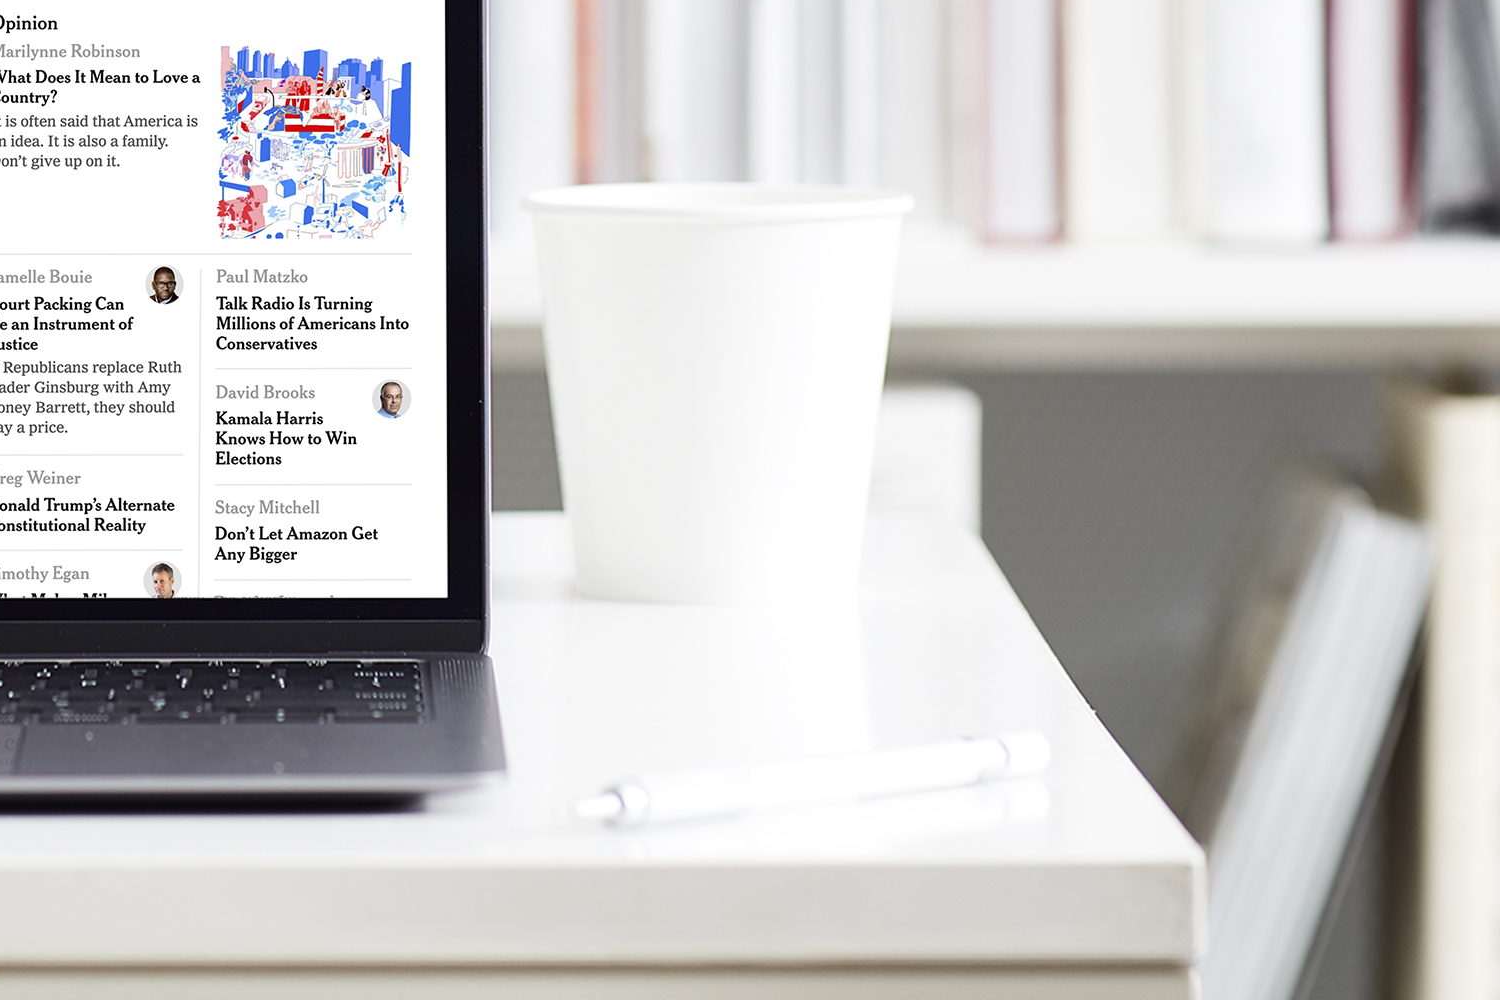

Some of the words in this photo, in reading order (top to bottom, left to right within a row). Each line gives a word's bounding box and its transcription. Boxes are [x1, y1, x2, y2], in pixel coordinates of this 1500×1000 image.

[71, 44, 140, 58] Robinson
[35, 69, 71, 84] Does
[75, 69, 86, 83] It
[90, 69, 131, 83] Mean
[135, 72, 149, 83] to
[153, 69, 188, 83] Love
[192, 74, 201, 83] a
[50, 269, 92, 283] Bouie
[217, 269, 248, 283] Paul
[253, 269, 308, 283] Matzko
[216, 316, 276, 330] Millions
[279, 316, 295, 330] of
[297, 316, 376, 330] Americans
[380, 316, 409, 330] Into
[216, 336, 317, 350] Conservatives
[3, 361, 88, 376] Republicans
[93, 361, 144, 376] replace
[148, 361, 182, 373] Ruth
[216, 385, 259, 399] David
[264, 385, 315, 399] Brooks
[216, 451, 282, 465] Elections
[215, 500, 255, 517] Stacy
[259, 500, 319, 514] Mitchell
[53, 565, 89, 583] Egan
